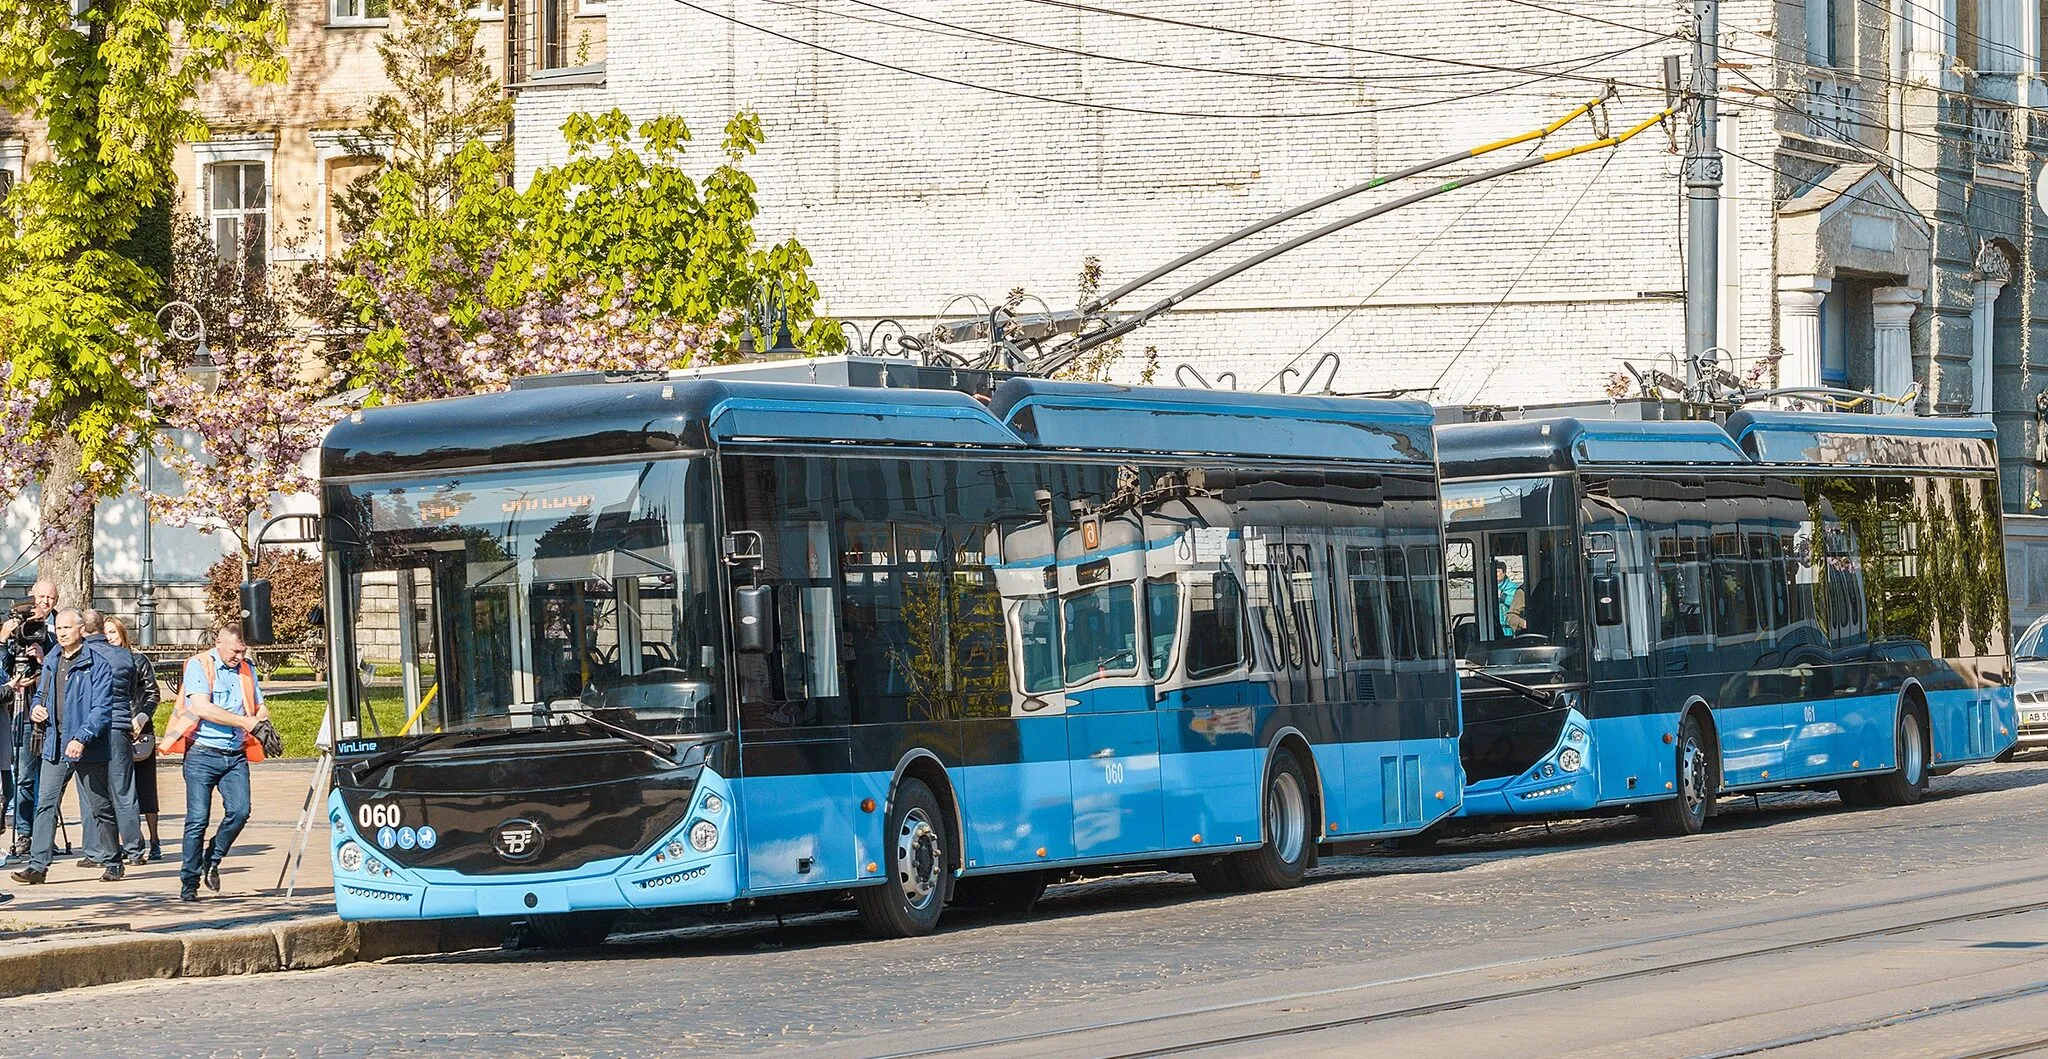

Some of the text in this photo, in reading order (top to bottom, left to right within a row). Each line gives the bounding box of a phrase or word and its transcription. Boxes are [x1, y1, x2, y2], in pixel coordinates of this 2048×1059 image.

[2029, 713, 2041, 722] AB
[338, 741, 377, 753] VinLine
[1105, 762, 1124, 785] 060
[358, 803, 401, 828] 060
